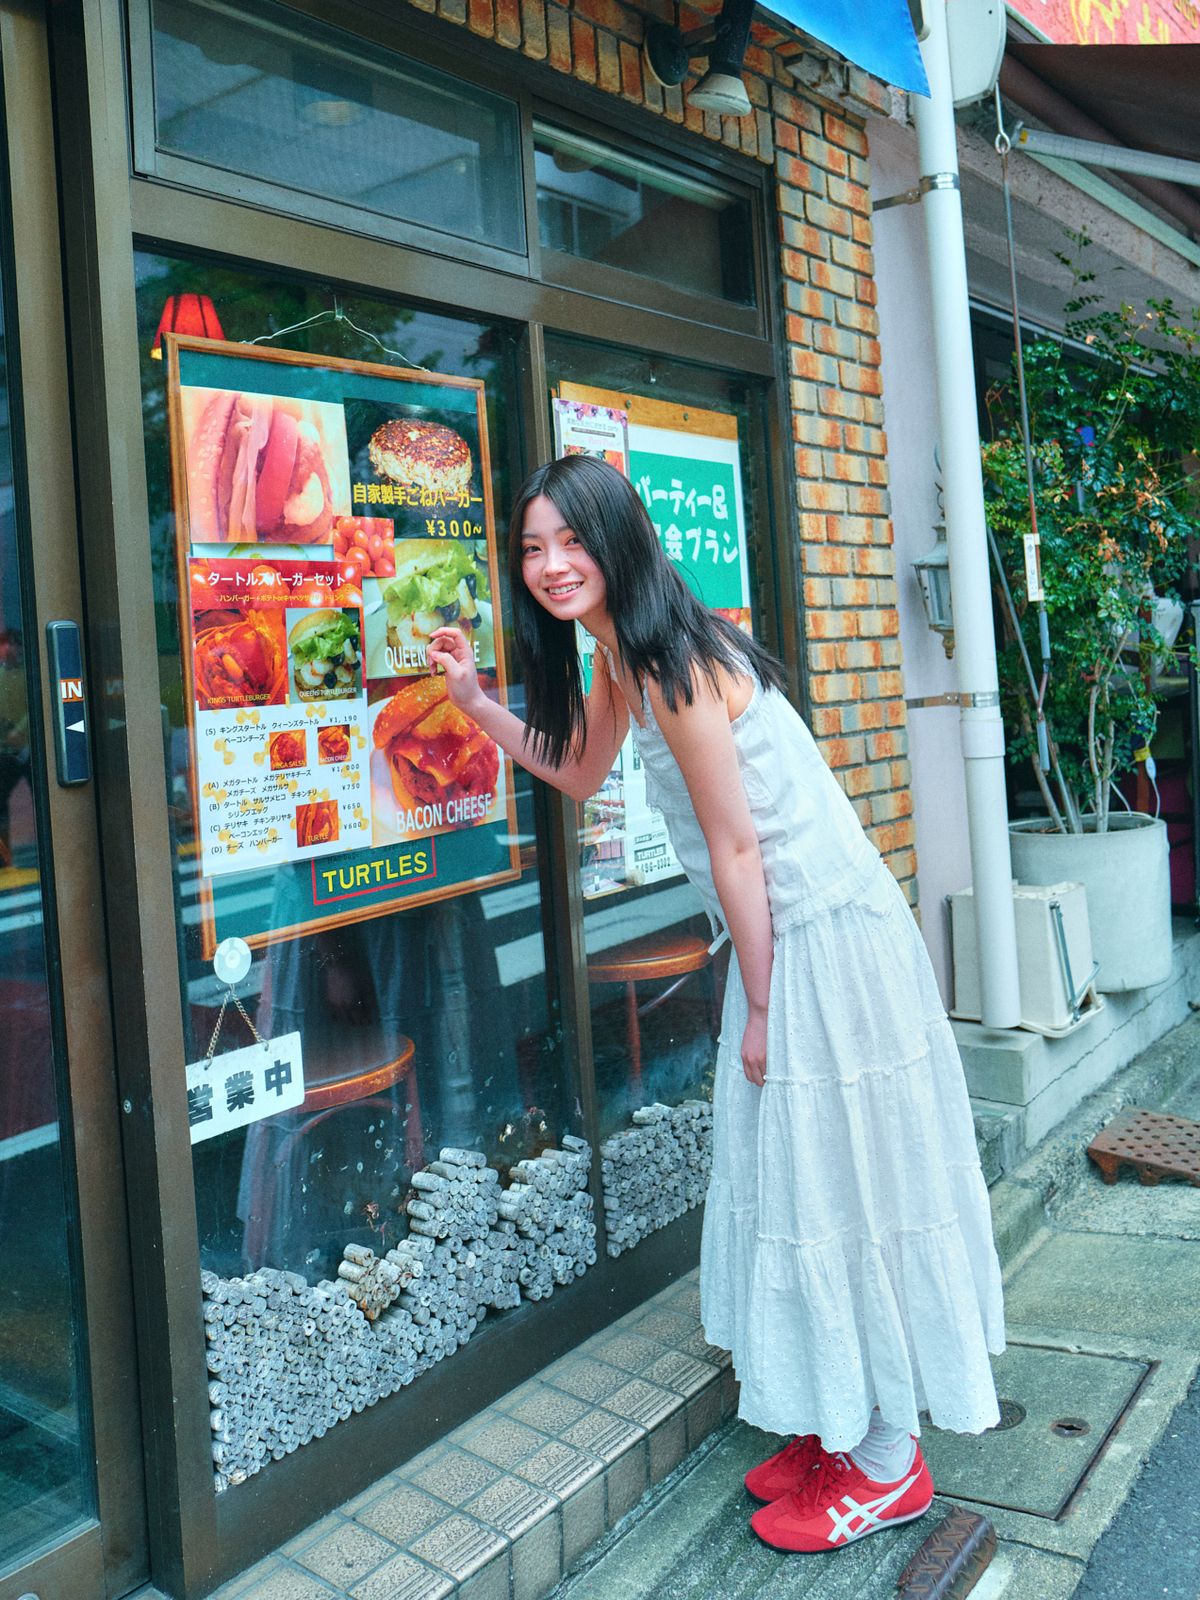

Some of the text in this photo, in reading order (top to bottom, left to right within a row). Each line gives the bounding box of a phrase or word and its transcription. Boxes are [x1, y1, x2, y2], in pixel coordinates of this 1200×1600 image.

[353, 483, 483, 508] 自家製手ごねバーガー
[655, 526, 739, 564] 会プラン
[384, 644, 428, 675] QUEEN
[61, 681, 83, 699] IN
[207, 693, 271, 705] KINGS TURTLEBURGER
[205, 727, 216, 736] (S)
[224, 733, 266, 744] ベーコンチーズ
[207, 781, 219, 790] (A)
[223, 777, 259, 788] メガタートル
[226, 787, 257, 798] メガチーズ
[209, 802, 220, 812] (B)
[223, 798, 248, 809] タートル
[343, 802, 361, 811] ¥650
[396, 792, 492, 834] BACON CHEESE
[210, 825, 221, 834] (C)
[211, 846, 222, 855] (D)
[226, 839, 244, 851] チーズ
[322, 851, 428, 893] TURTLES
[187, 1058, 292, 1127] 営業中
